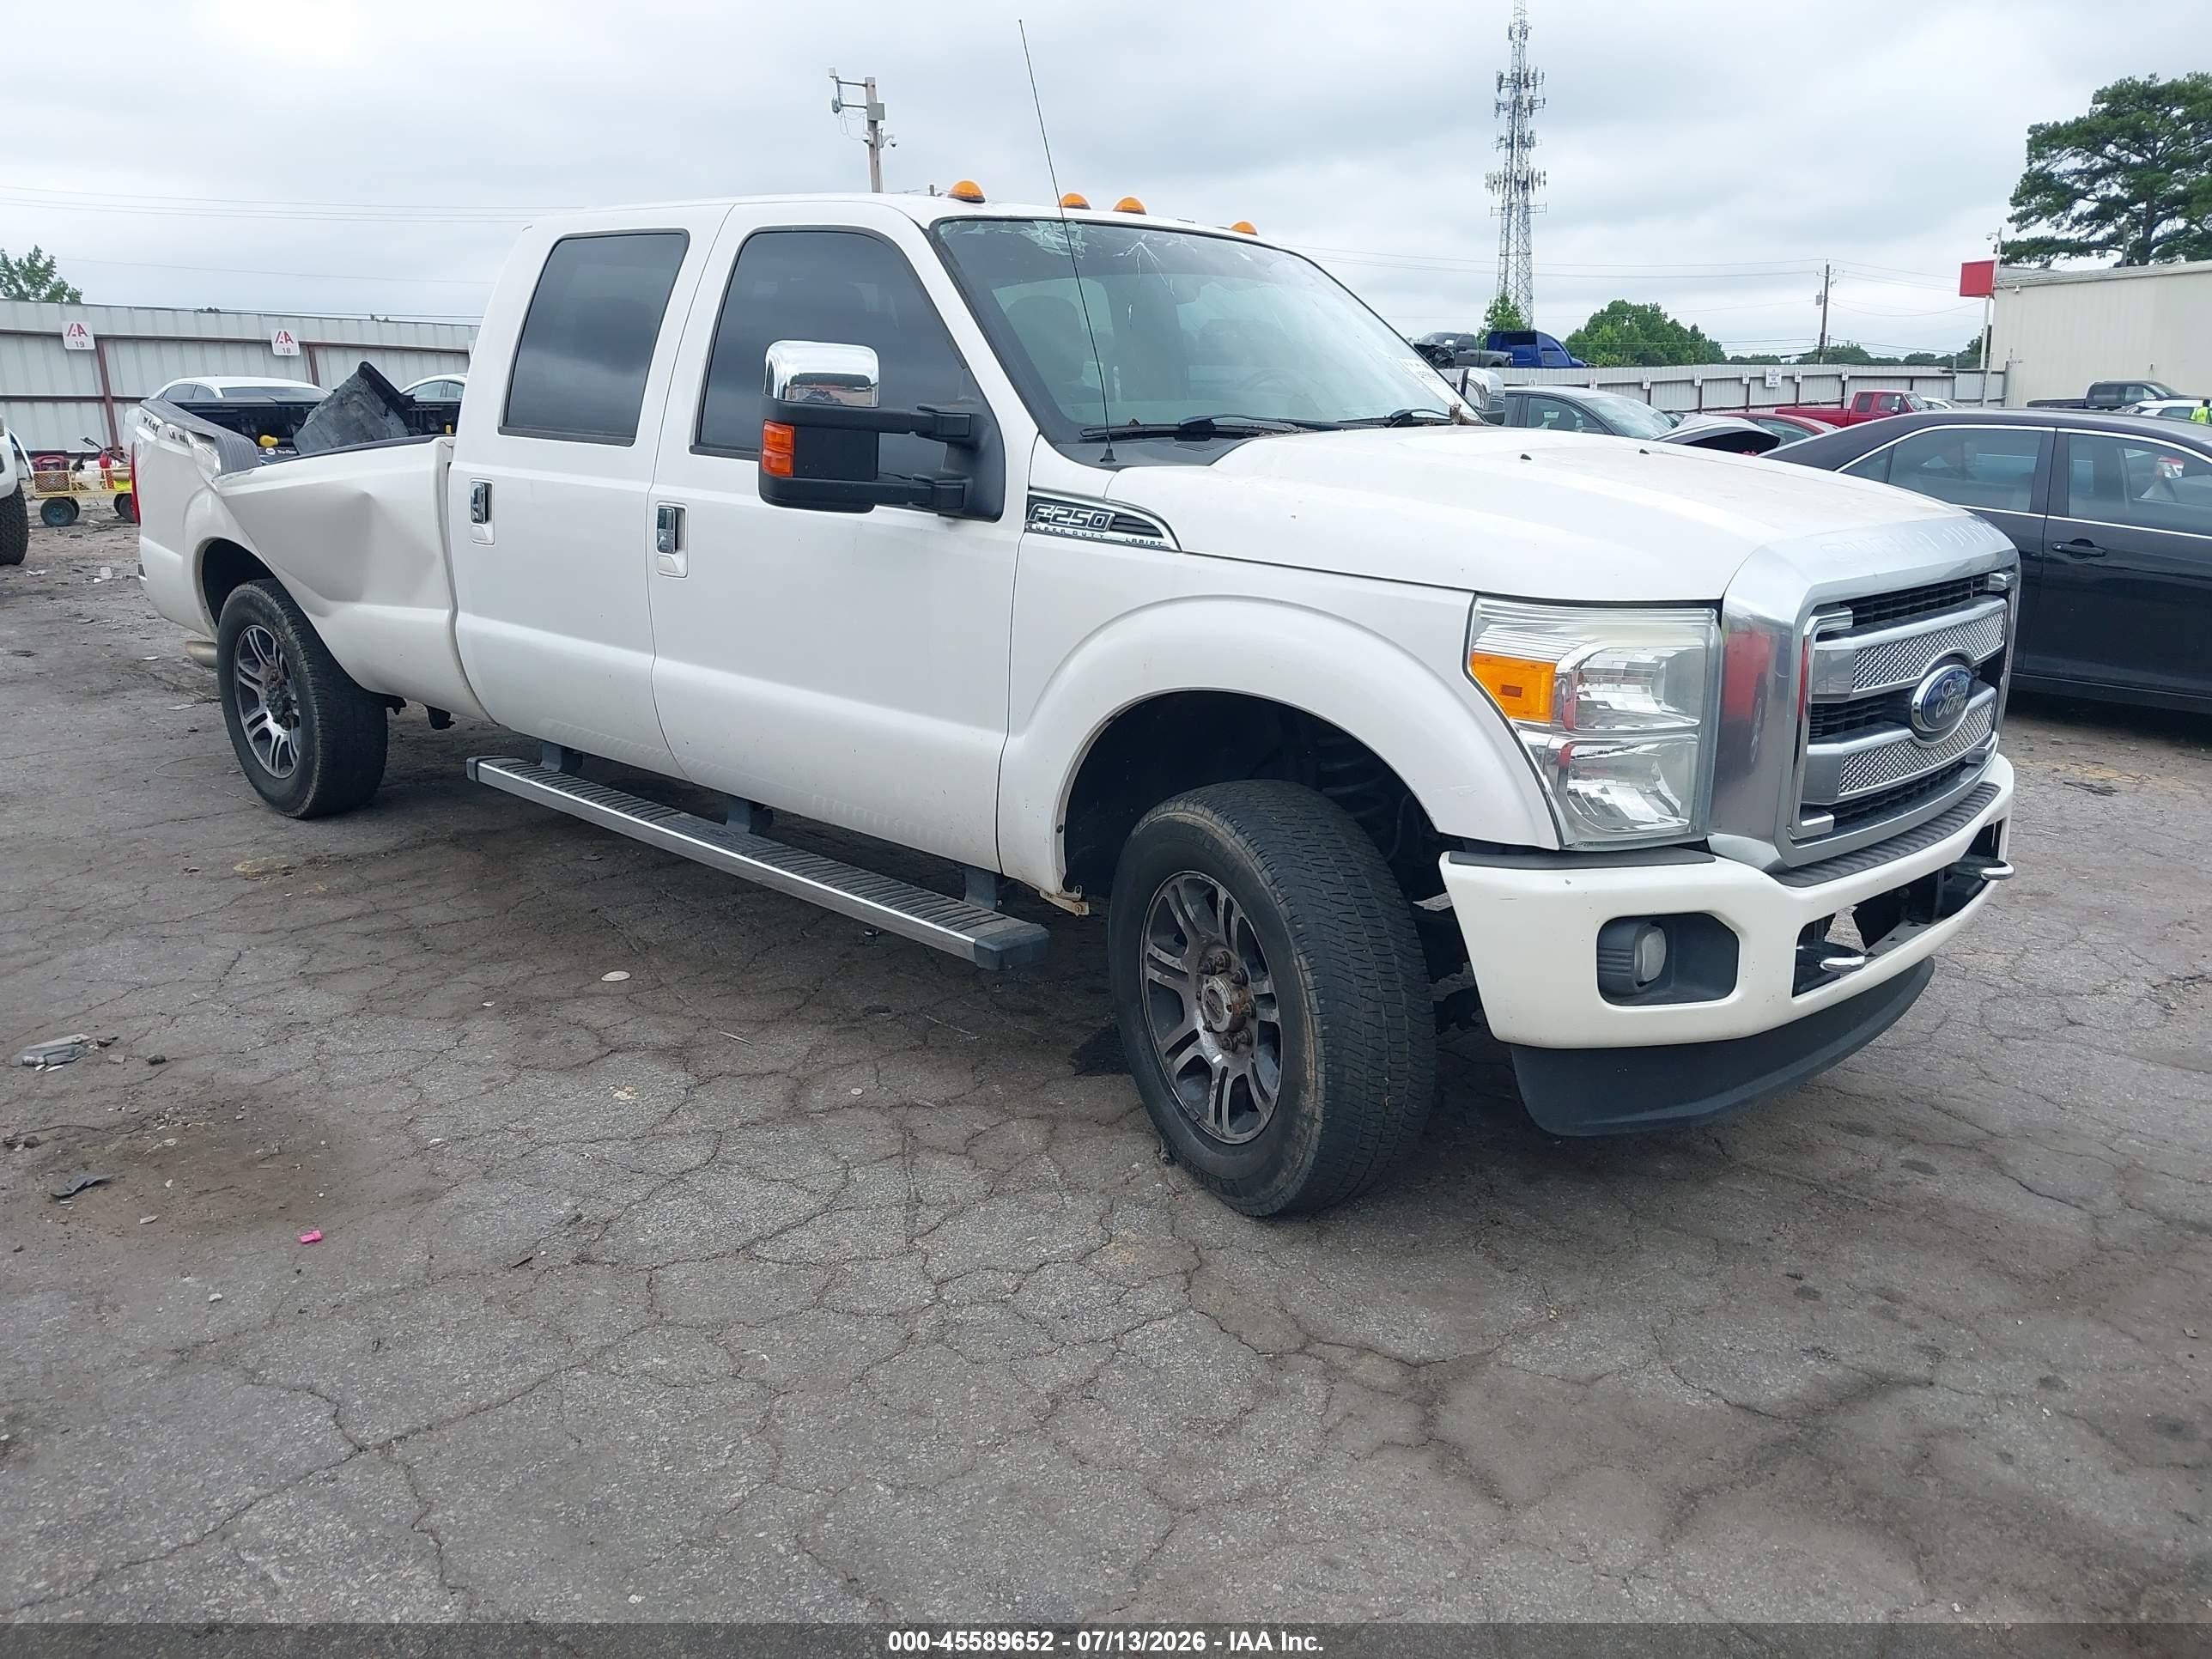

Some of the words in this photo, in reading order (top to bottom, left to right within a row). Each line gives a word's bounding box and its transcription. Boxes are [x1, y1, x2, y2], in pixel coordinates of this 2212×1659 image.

[1027, 503, 1115, 532] F-250
[1072, 530, 1104, 540] DUTY
[1125, 537, 1163, 547] LARIAT
[1936, 678, 1966, 719] Ford
